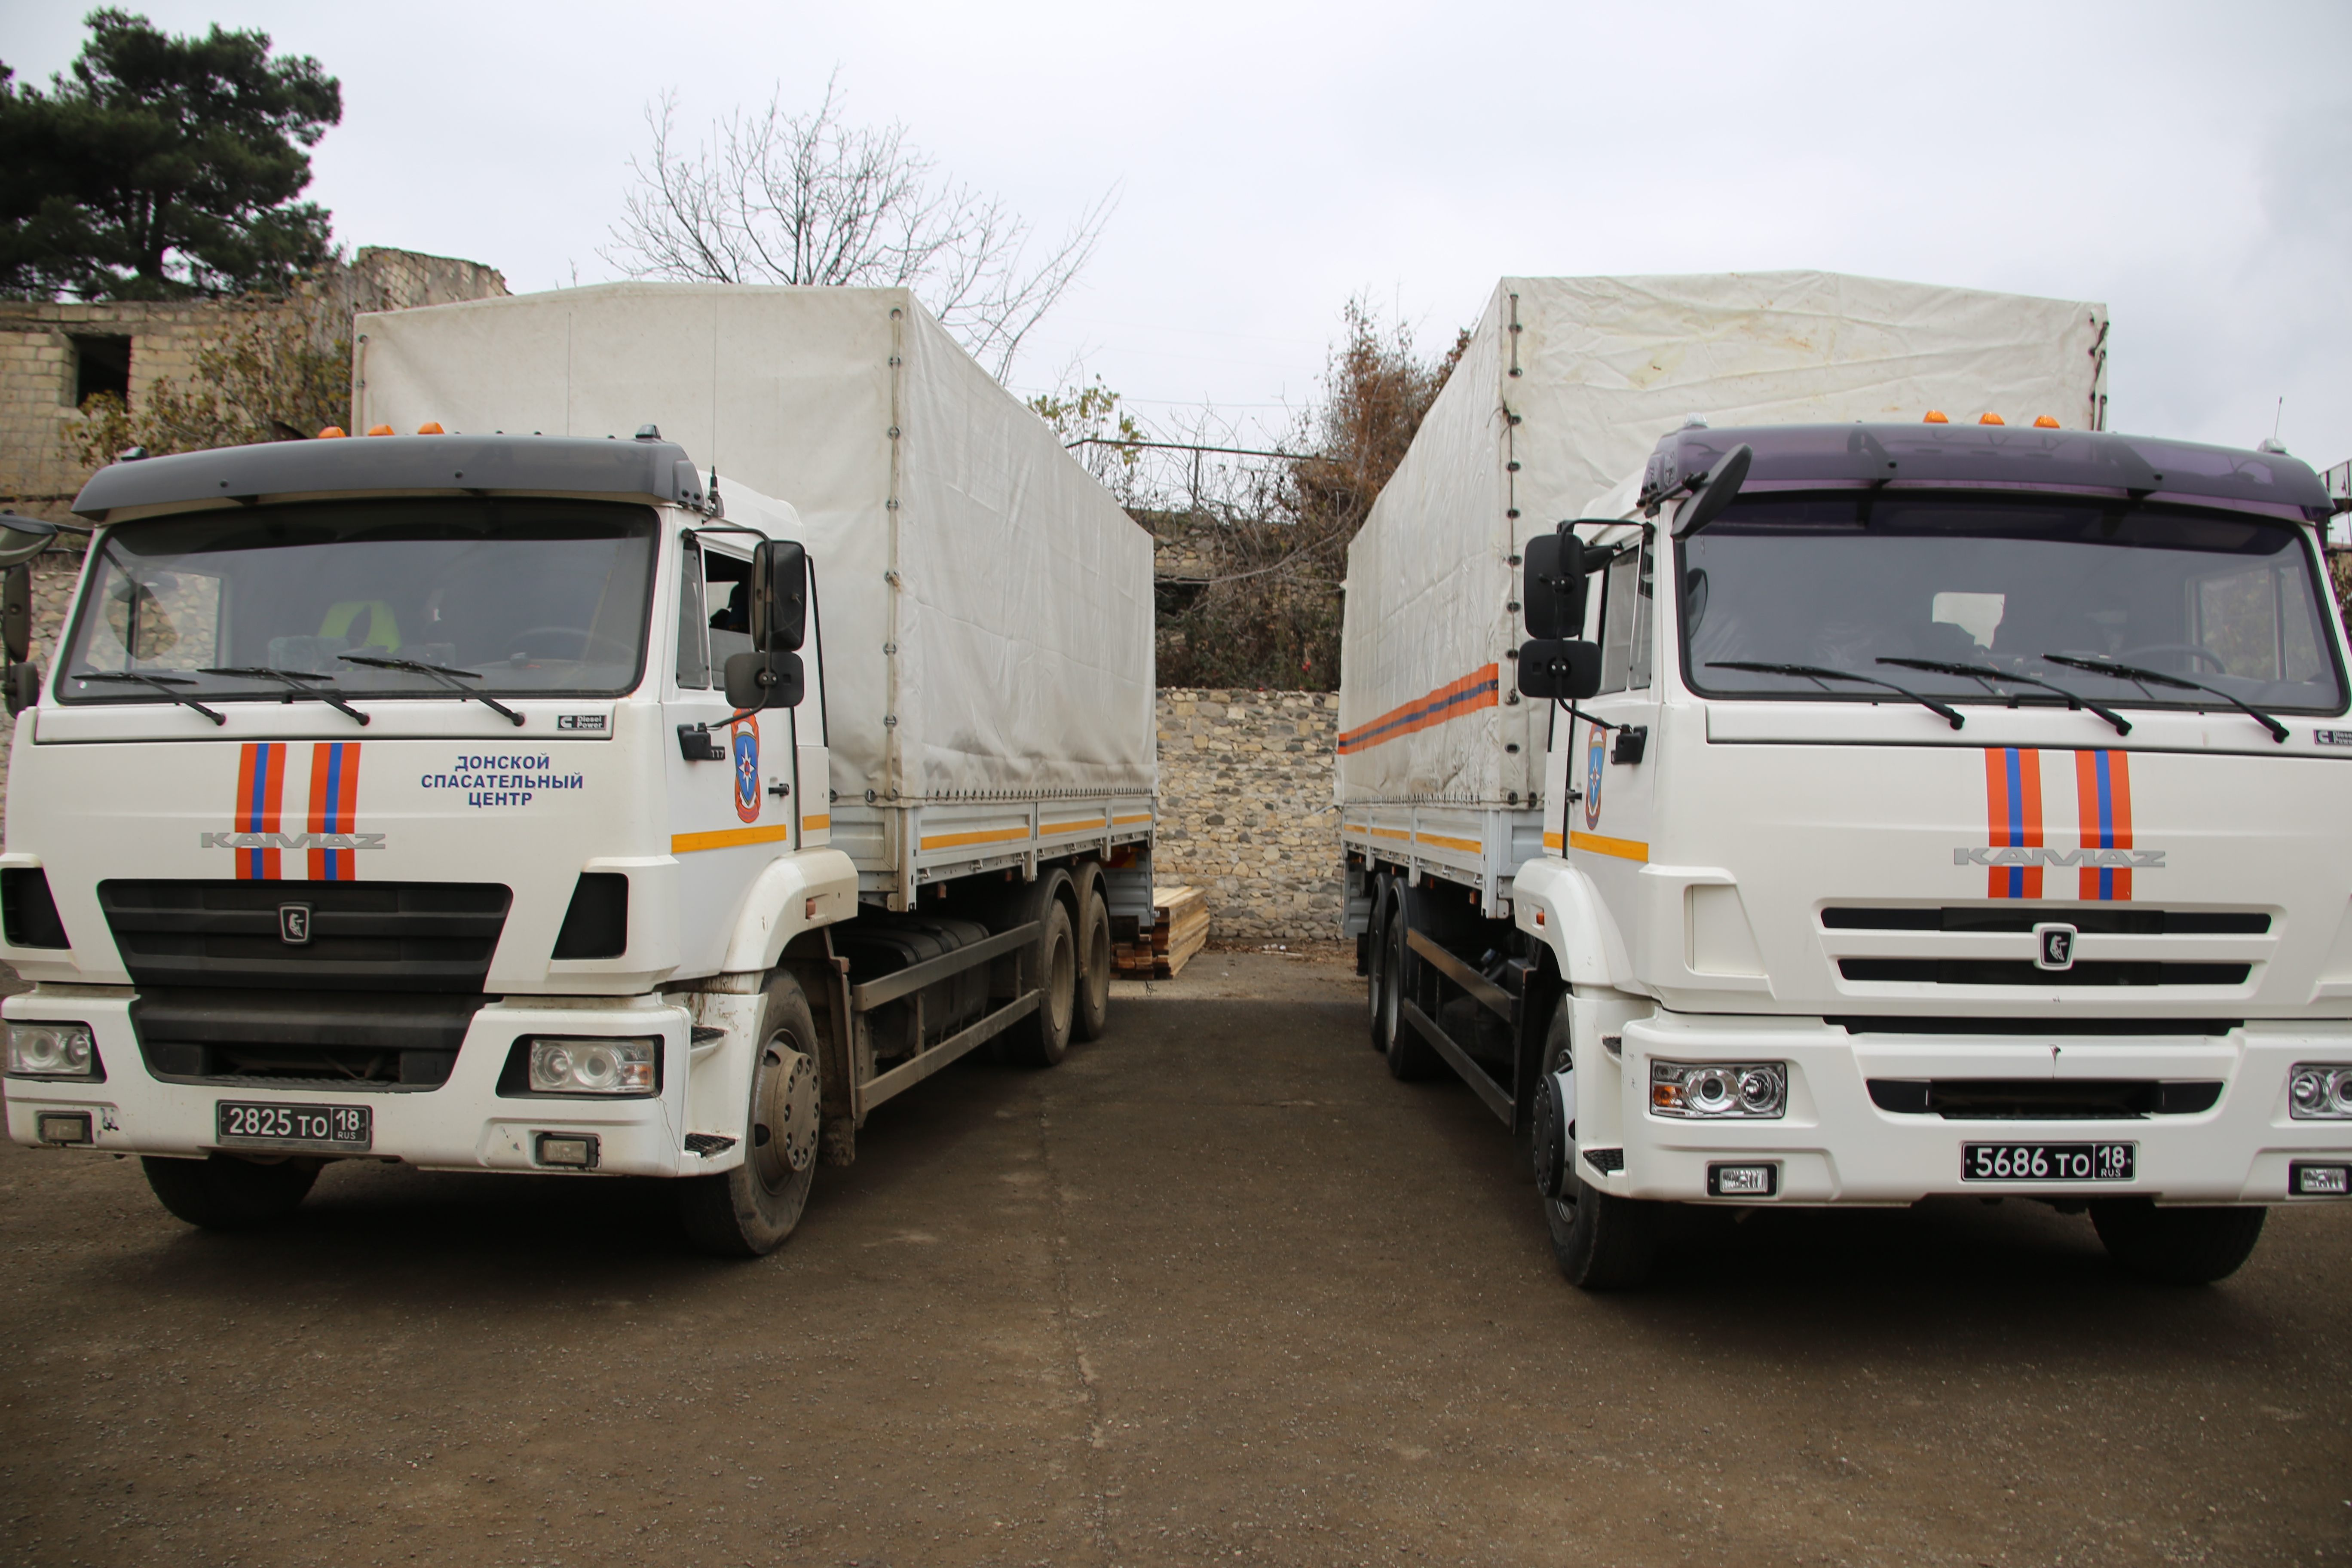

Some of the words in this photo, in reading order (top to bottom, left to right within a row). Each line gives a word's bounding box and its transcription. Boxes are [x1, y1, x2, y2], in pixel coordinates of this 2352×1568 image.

[455, 752, 550, 772] ДОНСКОЙ
[421, 772, 583, 789] СПАСАТЕЛЬНЫЙ
[469, 792, 533, 808] ЦЕНТР
[201, 832, 386, 849] KAMAZ
[1954, 848, 2165, 867] KAMAZ
[229, 1107, 292, 1136] 2825
[335, 1110, 359, 1131] 18
[337, 1131, 356, 1139] RUS
[1975, 1147, 2048, 1177] 5686
[2098, 1146, 2125, 1168] 18
[2101, 1168, 2121, 1178] RUS
